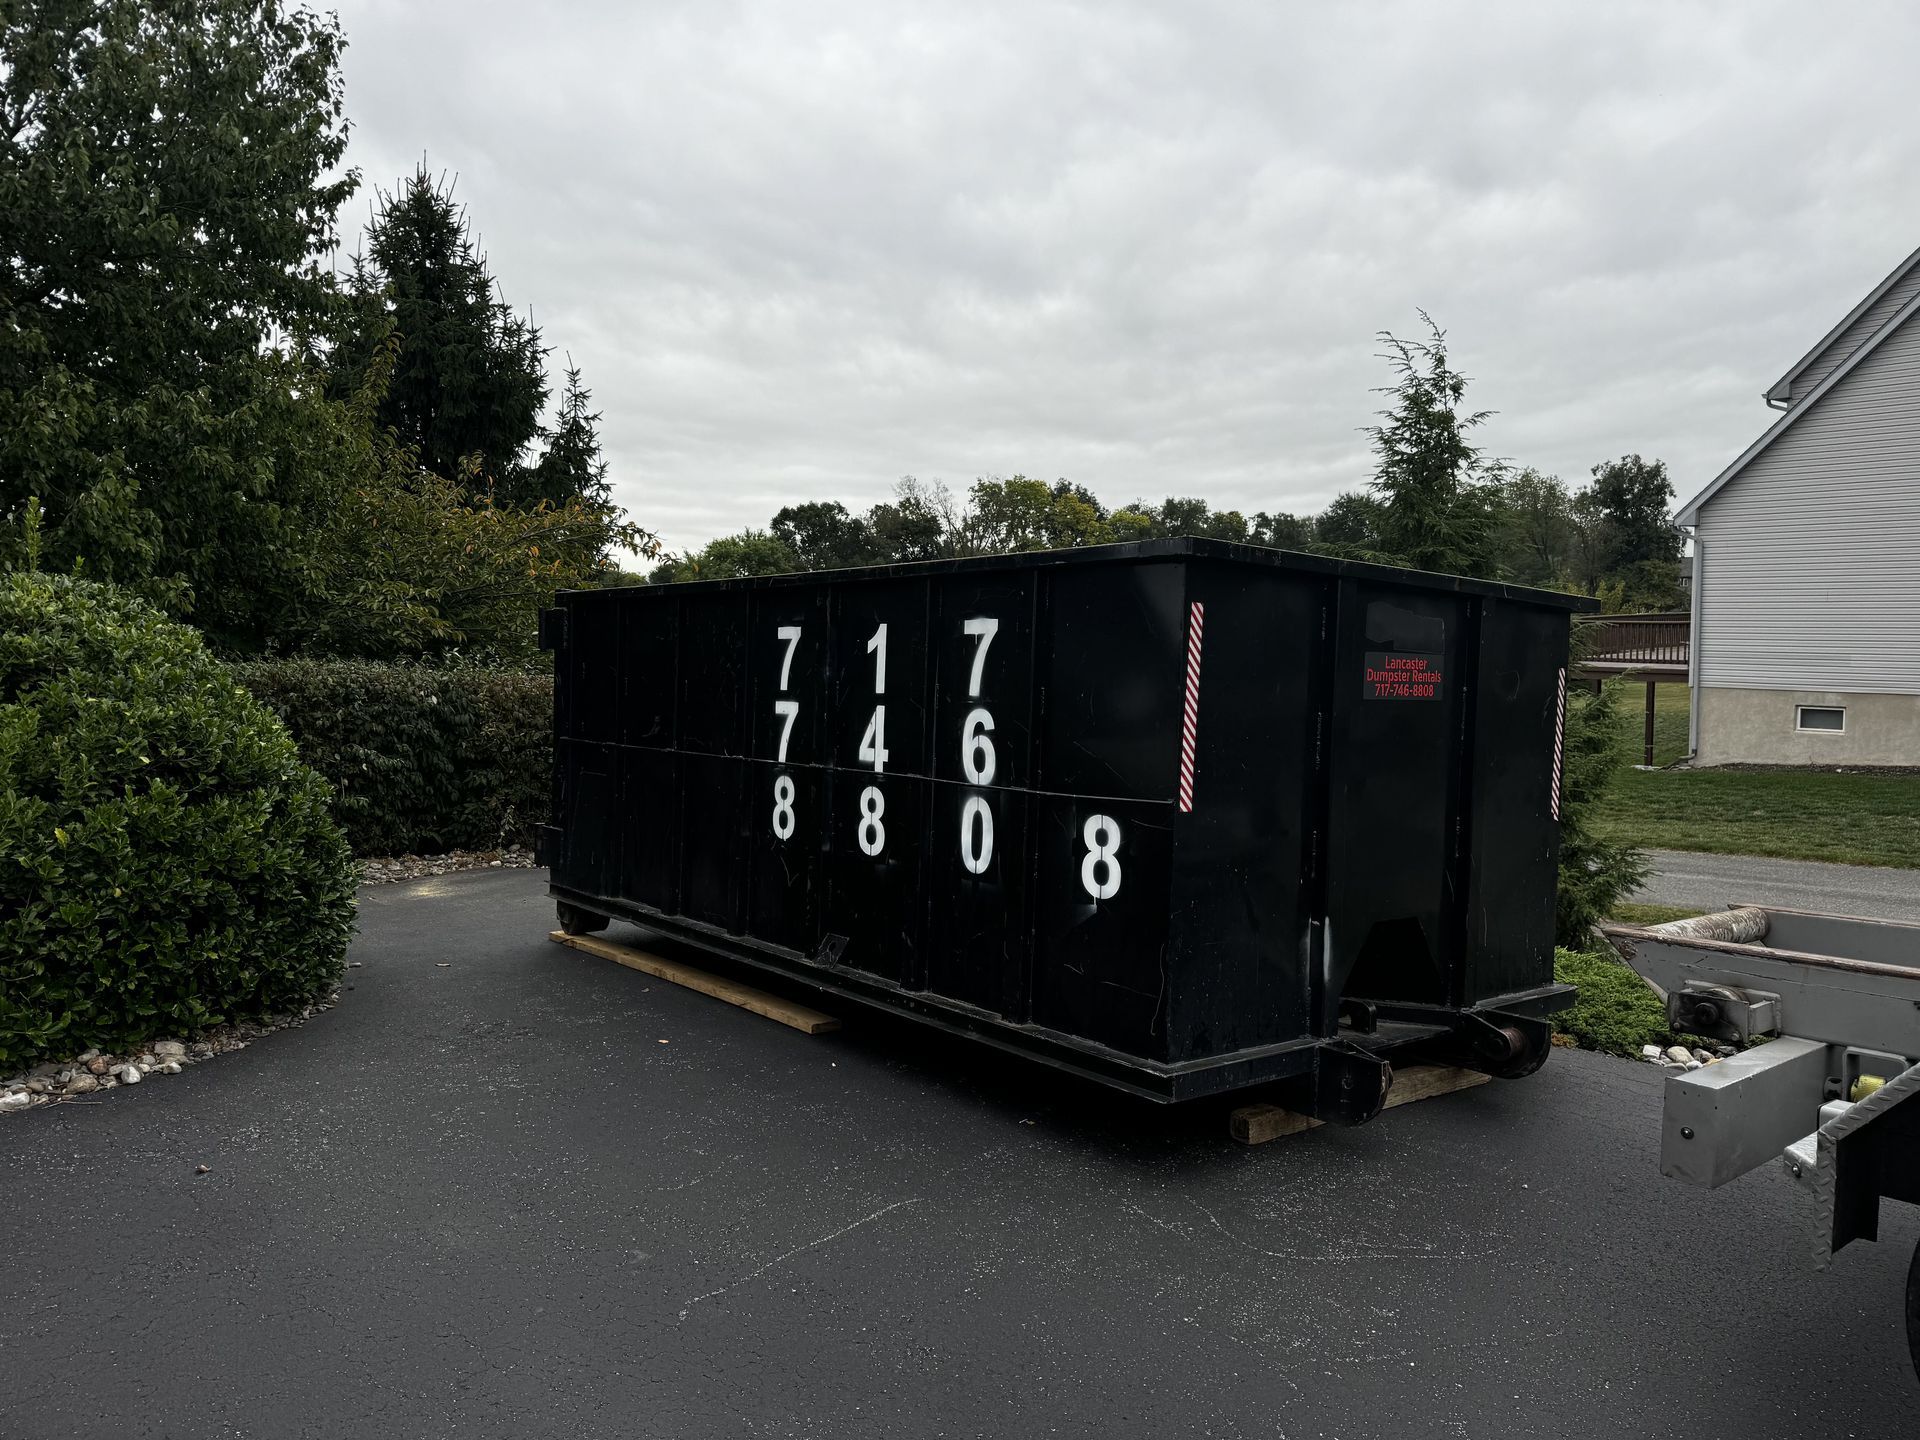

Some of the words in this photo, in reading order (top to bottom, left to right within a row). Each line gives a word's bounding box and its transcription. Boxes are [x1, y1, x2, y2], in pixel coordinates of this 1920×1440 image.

[778, 626, 801, 690] 7
[867, 623, 888, 693] 1
[963, 618, 998, 696] 7
[1366, 668, 1411, 684] Dumpster
[1412, 669, 1442, 683] Rentals
[1385, 655, 1428, 670] Lancaster
[1375, 683, 1434, 697] 717-746-8808
[775, 701, 799, 762] 7
[859, 705, 888, 773] 4
[962, 708, 996, 785] 6
[772, 775, 795, 841] 8
[858, 786, 885, 856] 8
[961, 796, 994, 874] 0
[1081, 814, 1122, 900] 8
